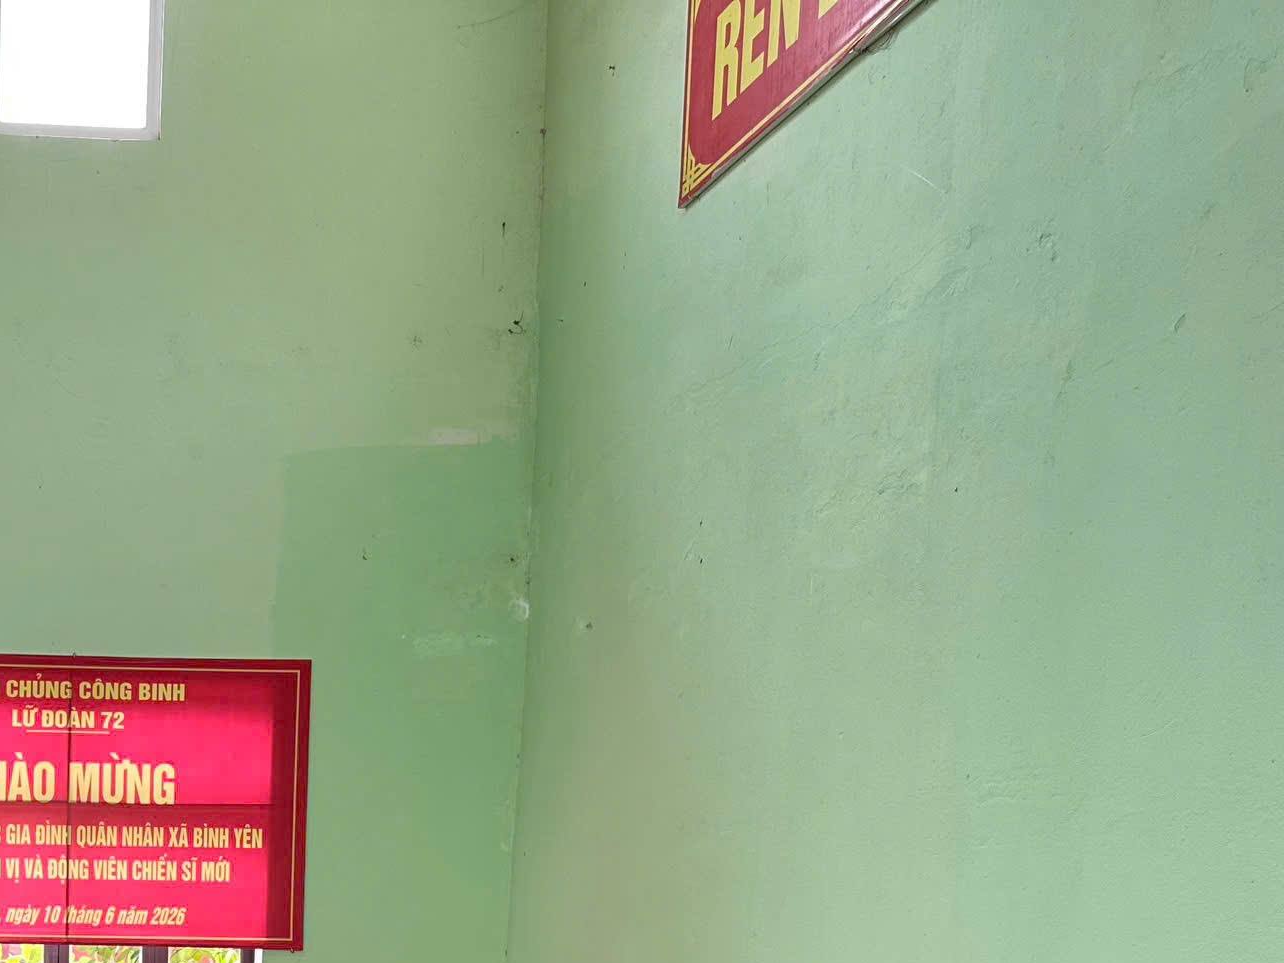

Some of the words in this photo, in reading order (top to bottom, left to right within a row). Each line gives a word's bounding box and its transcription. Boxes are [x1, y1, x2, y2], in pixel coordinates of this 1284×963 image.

[5, 673, 72, 698] CHỦNG
[79, 678, 132, 700] CÔNG
[138, 683, 185, 701] BINH
[12, 705, 38, 727] LỮ
[42, 707, 95, 729] ĐOÀN
[100, 711, 124, 729] 72
[68, 752, 176, 805] MỪNG
[6, 824, 30, 845] GIA
[36, 820, 72, 845] ĐÌNH
[76, 821, 117, 848] QUÂN
[122, 823, 164, 847] NHÂN
[168, 824, 189, 847] XÃ
[193, 823, 229, 848] BÌNH
[234, 824, 262, 848] YÊN
[6, 858, 20, 883] VỊ
[24, 855, 43, 878] VÀ
[48, 854, 89, 884] ĐỘNG
[94, 856, 127, 880] VIÊN
[132, 853, 176, 881] CHIẾN
[181, 857, 196, 881] SĨ
[202, 856, 230, 882] MỚI
[5, 905, 40, 925] ngày
[43, 906, 61, 923] 10
[105, 907, 115, 924] 6
[117, 907, 149, 924] năm
[150, 907, 186, 925] 2026
